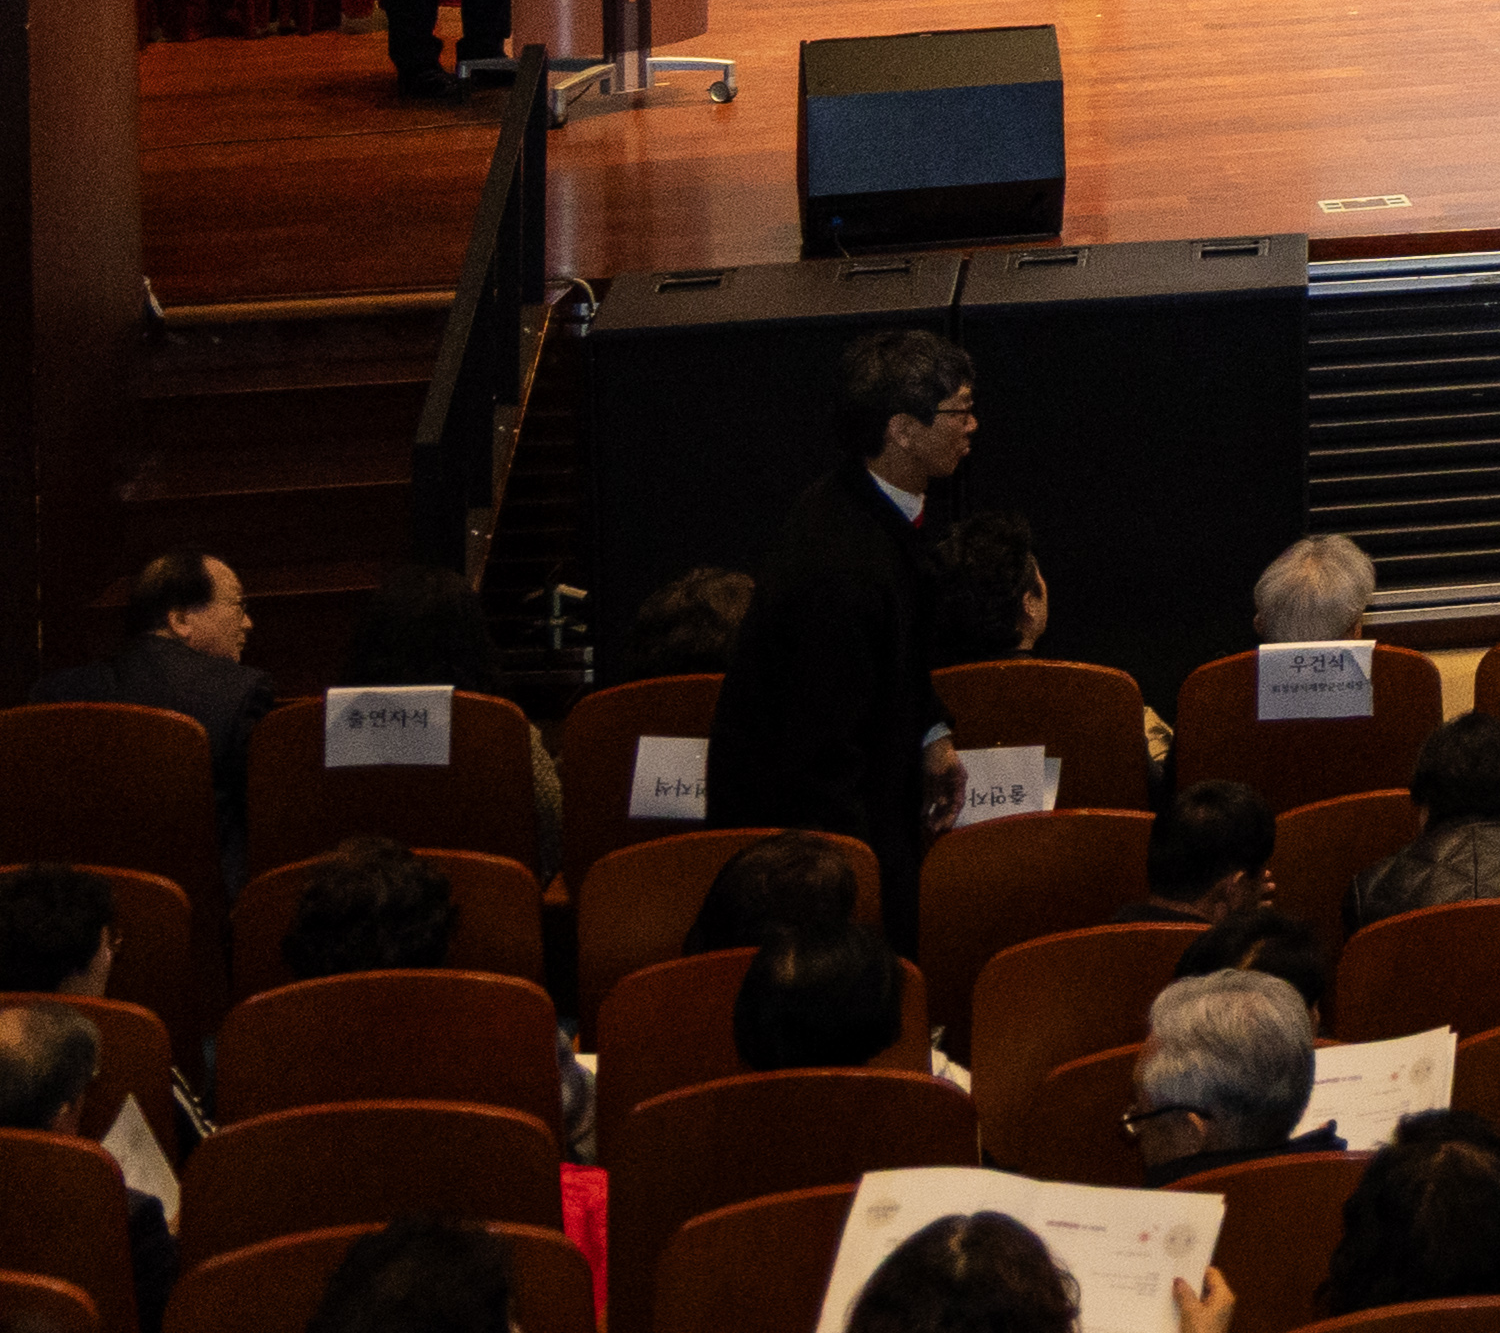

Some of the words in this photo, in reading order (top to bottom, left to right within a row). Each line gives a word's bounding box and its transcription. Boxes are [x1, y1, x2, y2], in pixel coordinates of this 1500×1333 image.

[1289, 653, 1344, 673] 우건식
[347, 707, 428, 730] 출연자석
[970, 785, 1026, 808] 출연자
